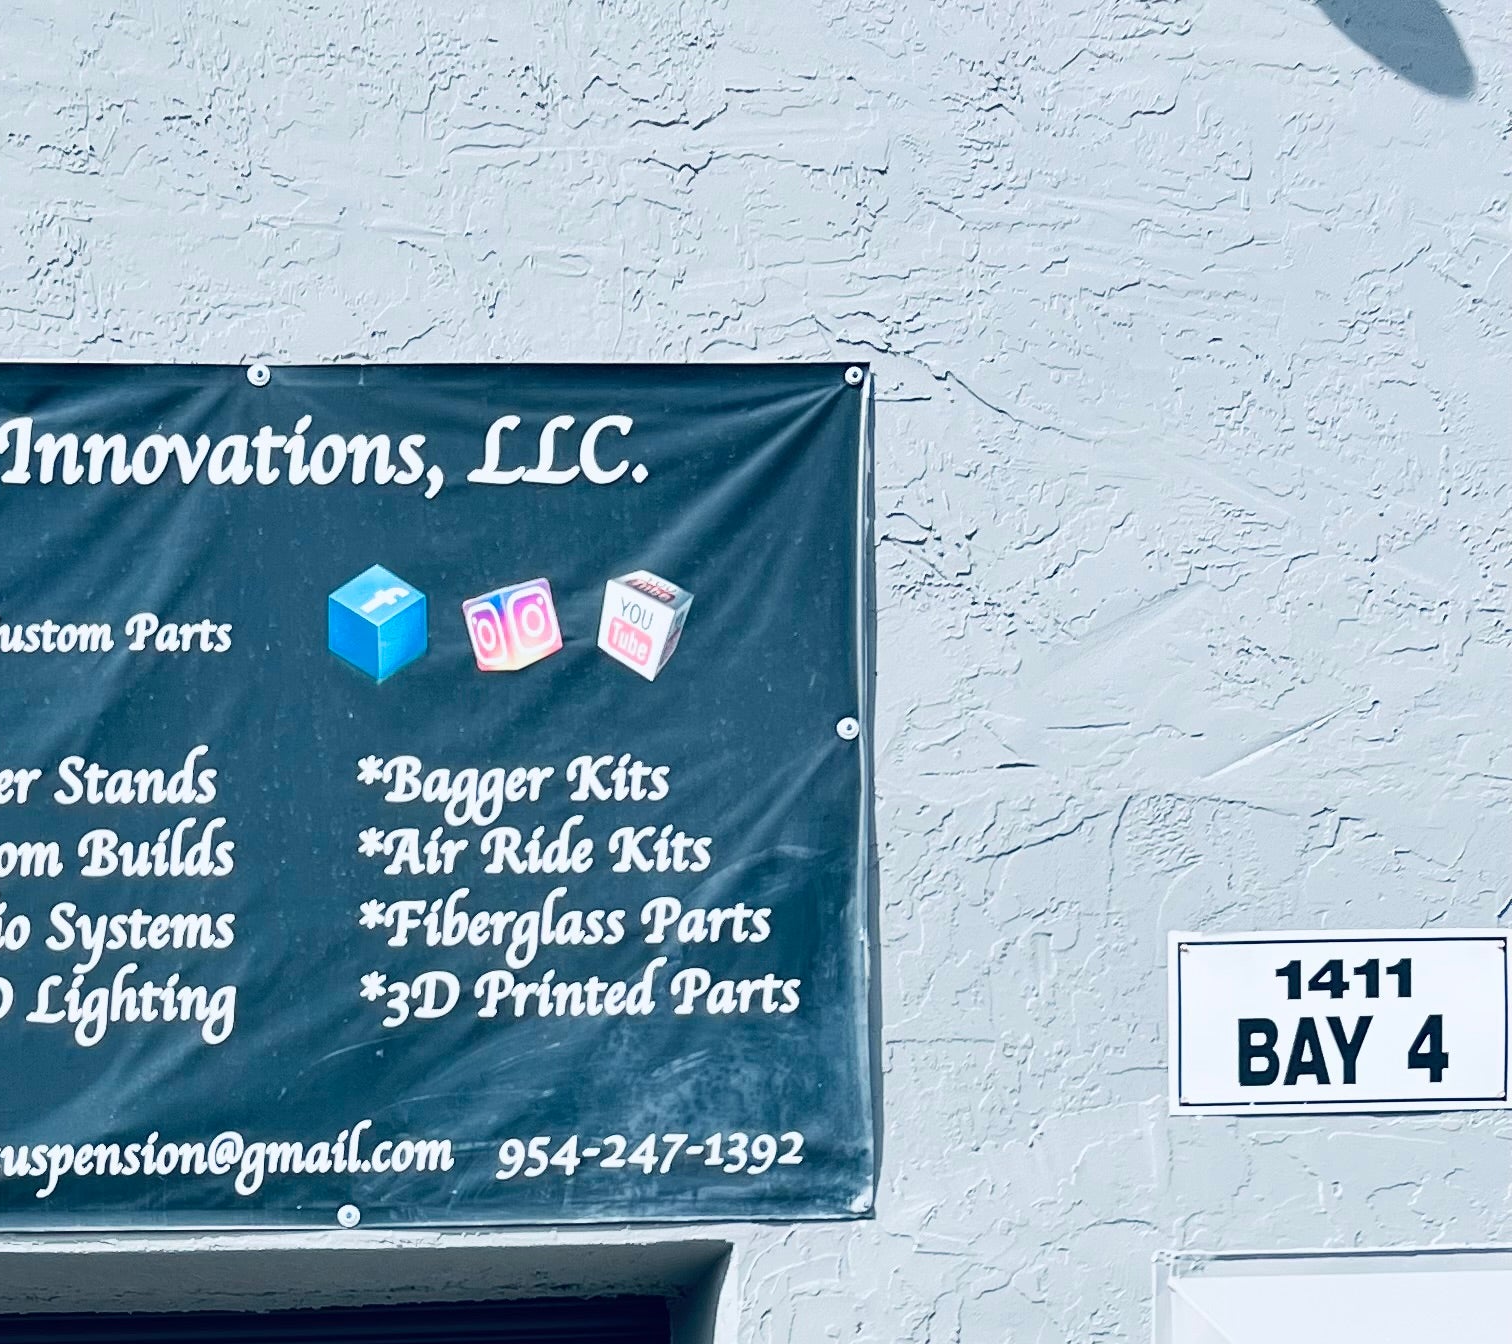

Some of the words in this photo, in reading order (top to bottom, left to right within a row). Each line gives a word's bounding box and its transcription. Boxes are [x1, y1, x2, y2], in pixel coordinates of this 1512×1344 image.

[467, 415, 649, 485] LLC.
[125, 612, 233, 653] Parts
[611, 621, 648, 660] Tube
[620, 595, 654, 631] YOU
[53, 744, 217, 805] Stands
[566, 753, 670, 801] Kits
[77, 817, 235, 877] Builds
[480, 814, 594, 874] Ride
[608, 824, 712, 873] Kits
[45, 902, 236, 974] Systems
[640, 896, 772, 944] Parts
[26, 962, 237, 1046] Lighting
[474, 956, 668, 1018] Printed
[670, 967, 801, 1015] Parts
[1275, 957, 1412, 1000] 1411
[1237, 1015, 1374, 1087] BAY
[1407, 1013, 1450, 1083] 4
[495, 1131, 804, 1180] 954-247-1392
